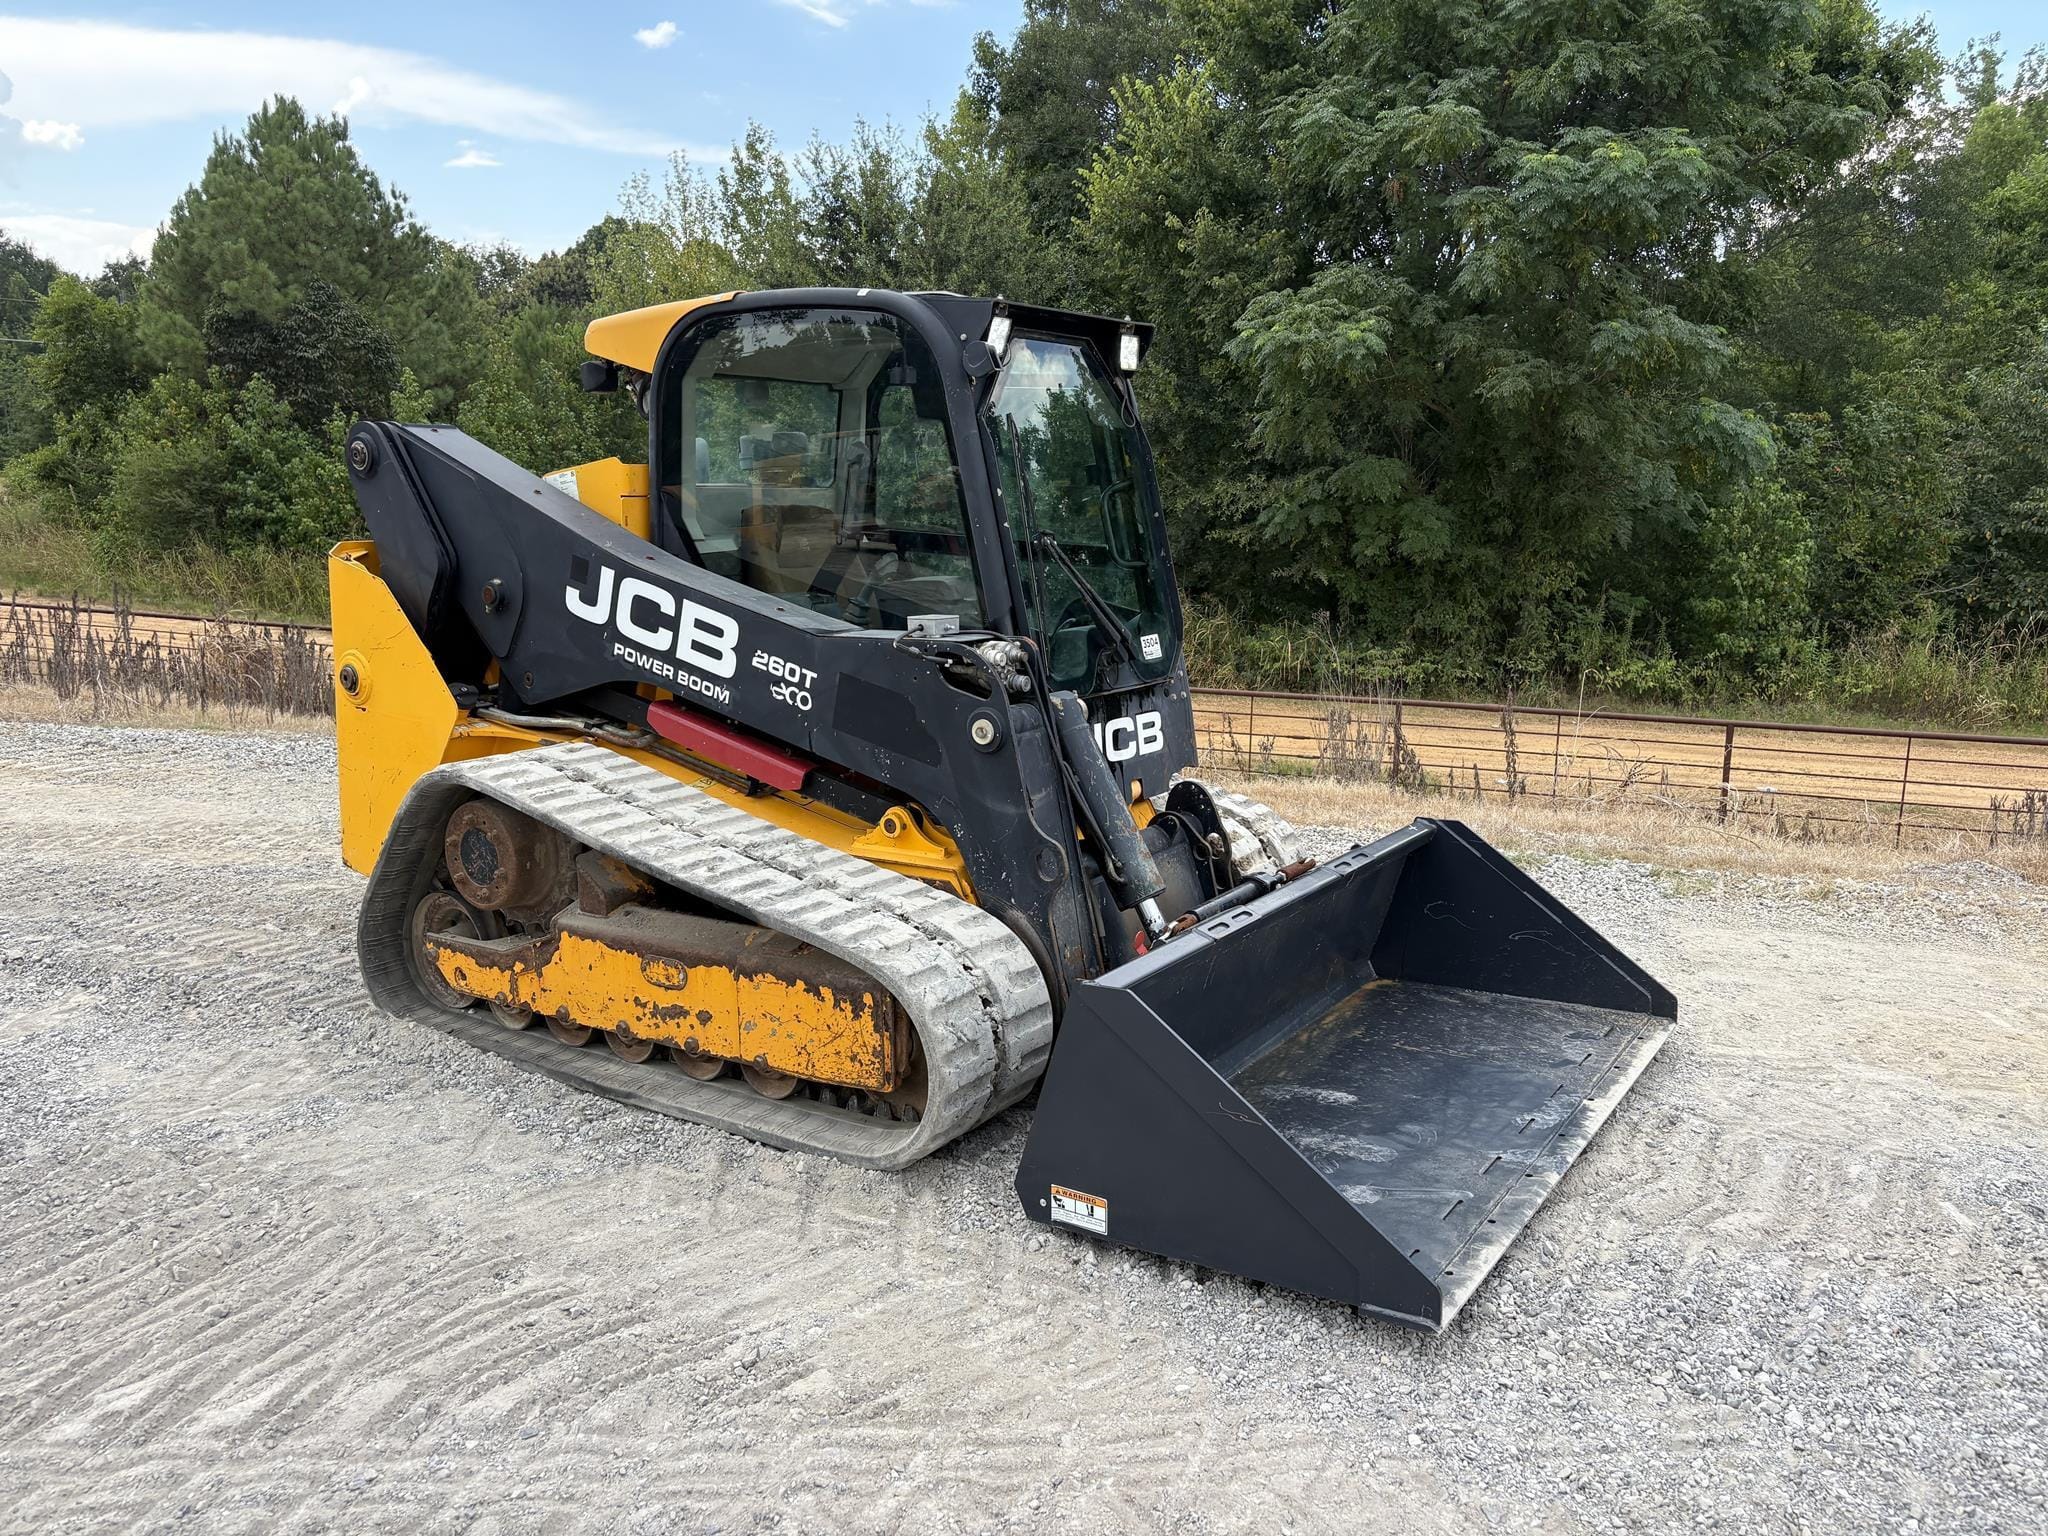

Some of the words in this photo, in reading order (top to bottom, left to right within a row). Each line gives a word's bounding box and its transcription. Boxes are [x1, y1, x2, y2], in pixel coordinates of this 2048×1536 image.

[565, 565, 739, 679] JCB
[613, 642, 674, 680] POWER
[677, 669, 730, 705] BOOM
[751, 649, 818, 689] 260T
[1062, 1190, 1097, 1205] WARNING
